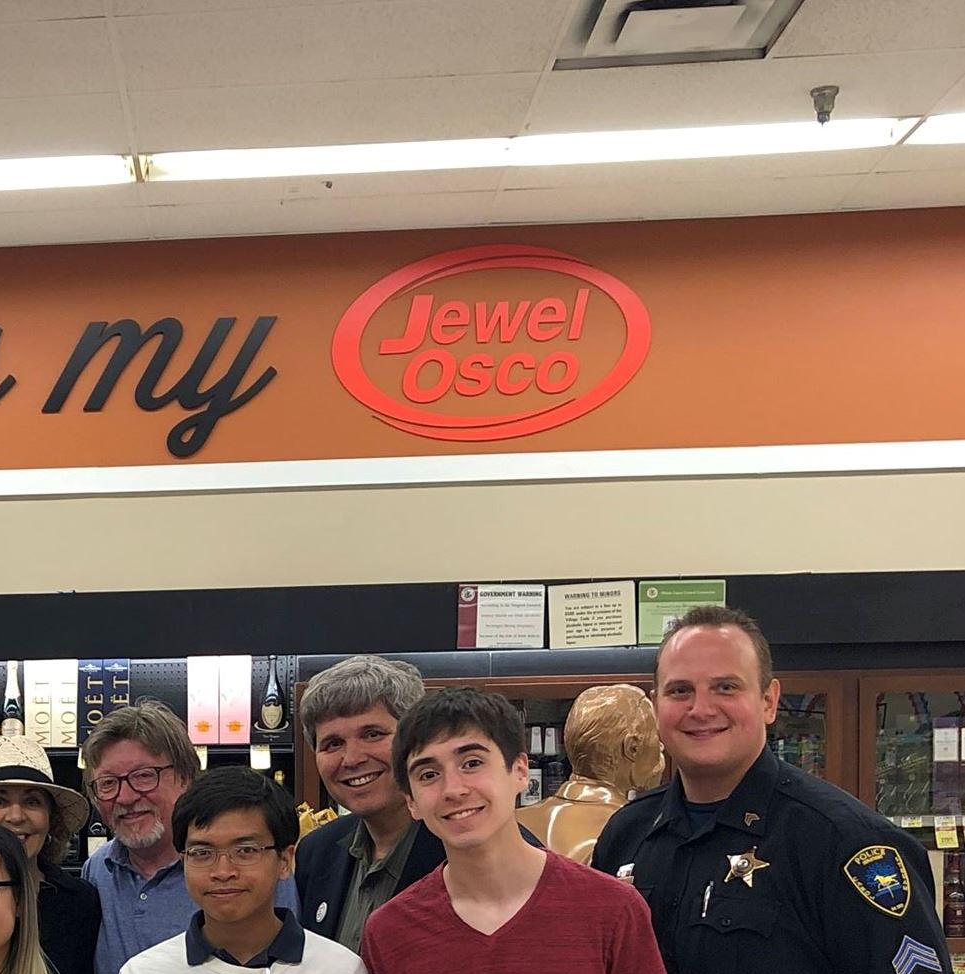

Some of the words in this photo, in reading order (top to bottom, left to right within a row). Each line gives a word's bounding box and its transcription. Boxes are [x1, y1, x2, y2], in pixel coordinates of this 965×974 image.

[379, 288, 589, 355] Jewel
[40, 316, 277, 458] my
[401, 349, 580, 404] Osco
